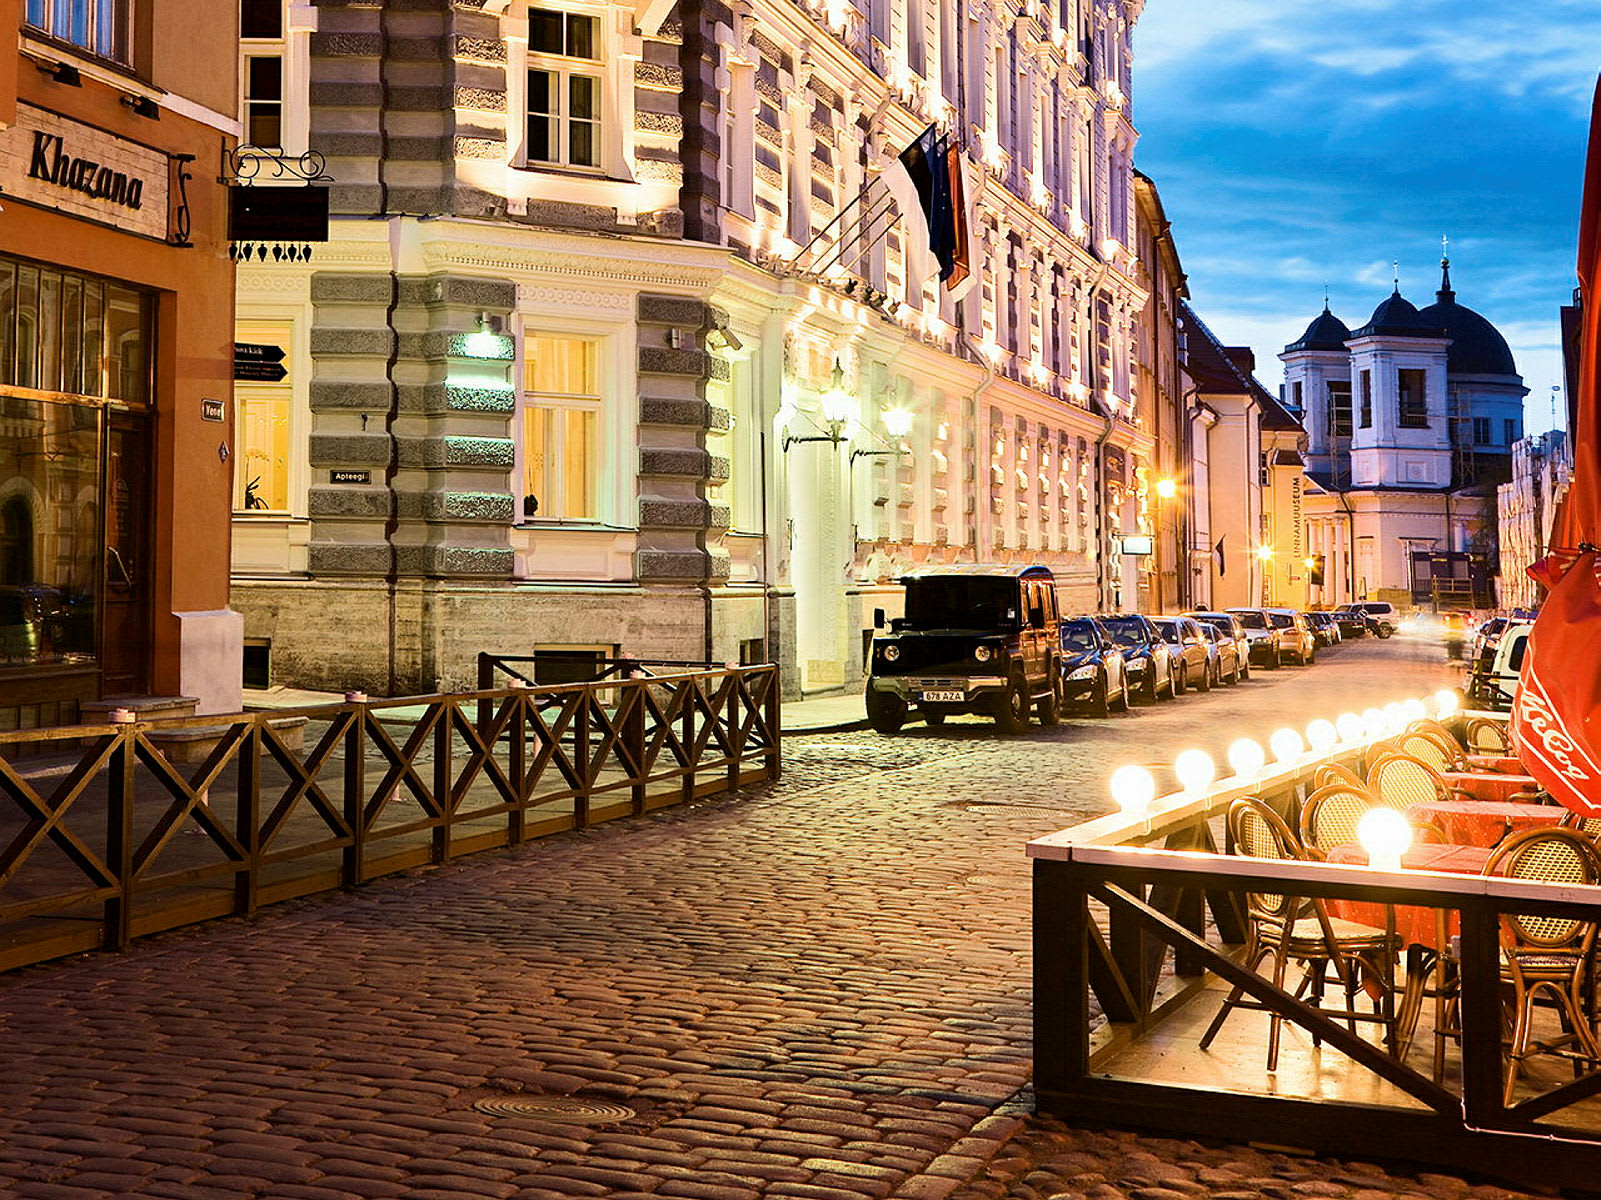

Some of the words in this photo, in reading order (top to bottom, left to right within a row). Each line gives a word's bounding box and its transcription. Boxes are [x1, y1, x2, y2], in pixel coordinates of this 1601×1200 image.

[28, 131, 143, 210] Khazana
[205, 404, 221, 417] Vene
[335, 472, 365, 482] Apteegi
[1292, 477, 1301, 558] LINNAMUUSEUM
[926, 692, 941, 701] 678
[942, 692, 961, 701] AZA
